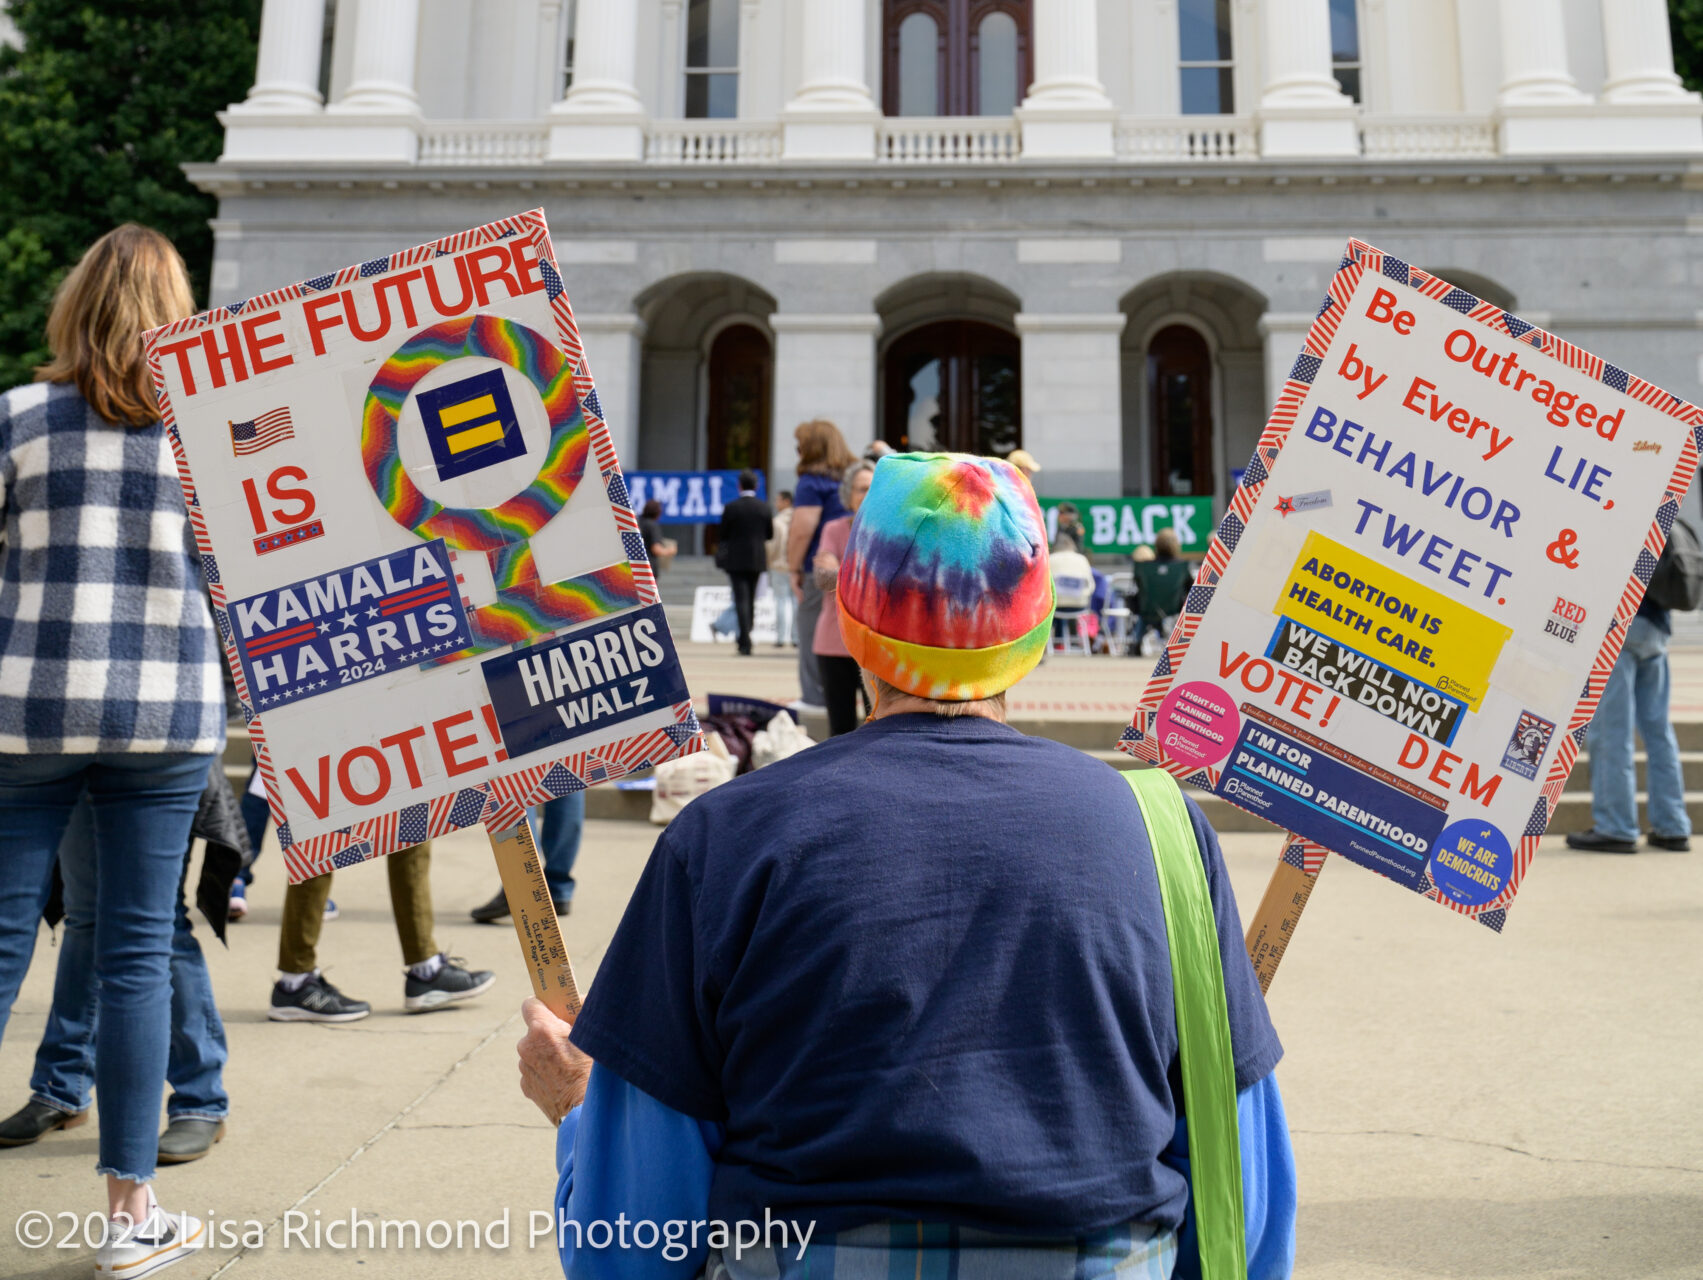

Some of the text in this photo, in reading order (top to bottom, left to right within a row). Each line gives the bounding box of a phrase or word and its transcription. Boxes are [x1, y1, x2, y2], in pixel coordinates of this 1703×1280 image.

[157, 237, 546, 397] THE FUTURE
[1365, 286, 1626, 442] Be Outraged
[1337, 343, 1615, 511] by Every LIE,
[241, 465, 316, 535] IS
[1304, 406, 1580, 570] BEHAVIOR &
[1089, 504, 1198, 545] BACK
[1354, 498, 1513, 606] TWEET.
[235, 546, 446, 639] KAMALA
[1301, 557, 1443, 635] ABORTION IS
[1552, 596, 1587, 625] RED
[251, 602, 458, 692] HARRIS
[1288, 582, 1436, 668] HEALTH CARE.
[1544, 619, 1578, 644] BLUE
[338, 657, 387, 684] 2024
[517, 617, 665, 708] HARRIS
[1288, 622, 1458, 721] WE WILL NOT
[555, 675, 655, 729] WALZ
[1175, 700, 1213, 723] PLANNED
[1185, 691, 1210, 708] FIGHT
[1209, 701, 1226, 716] FOR
[1282, 646, 1441, 739] BACK DOWN
[1169, 712, 1224, 743] PARENTHOOD
[1218, 640, 1503, 808] VOTE! DEM
[1246, 728, 1312, 770] I'M FOR
[285, 703, 510, 820] VOTE!
[1503, 757, 1535, 779] LIBERTY
[1235, 752, 1428, 853] PLANNED PARENTHOOD
[1239, 781, 1264, 797] Planned
[1349, 840, 1417, 878] PlannedParenthood.org
[1436, 848, 1502, 891] DEMOCRATS
[1456, 836, 1498, 868] WE ARE
[521, 914, 532, 939] Cleaner
[530, 945, 538, 962] Rags
[532, 922, 549, 965] CLEAN UP
[1254, 943, 1268, 971] CLEAN
